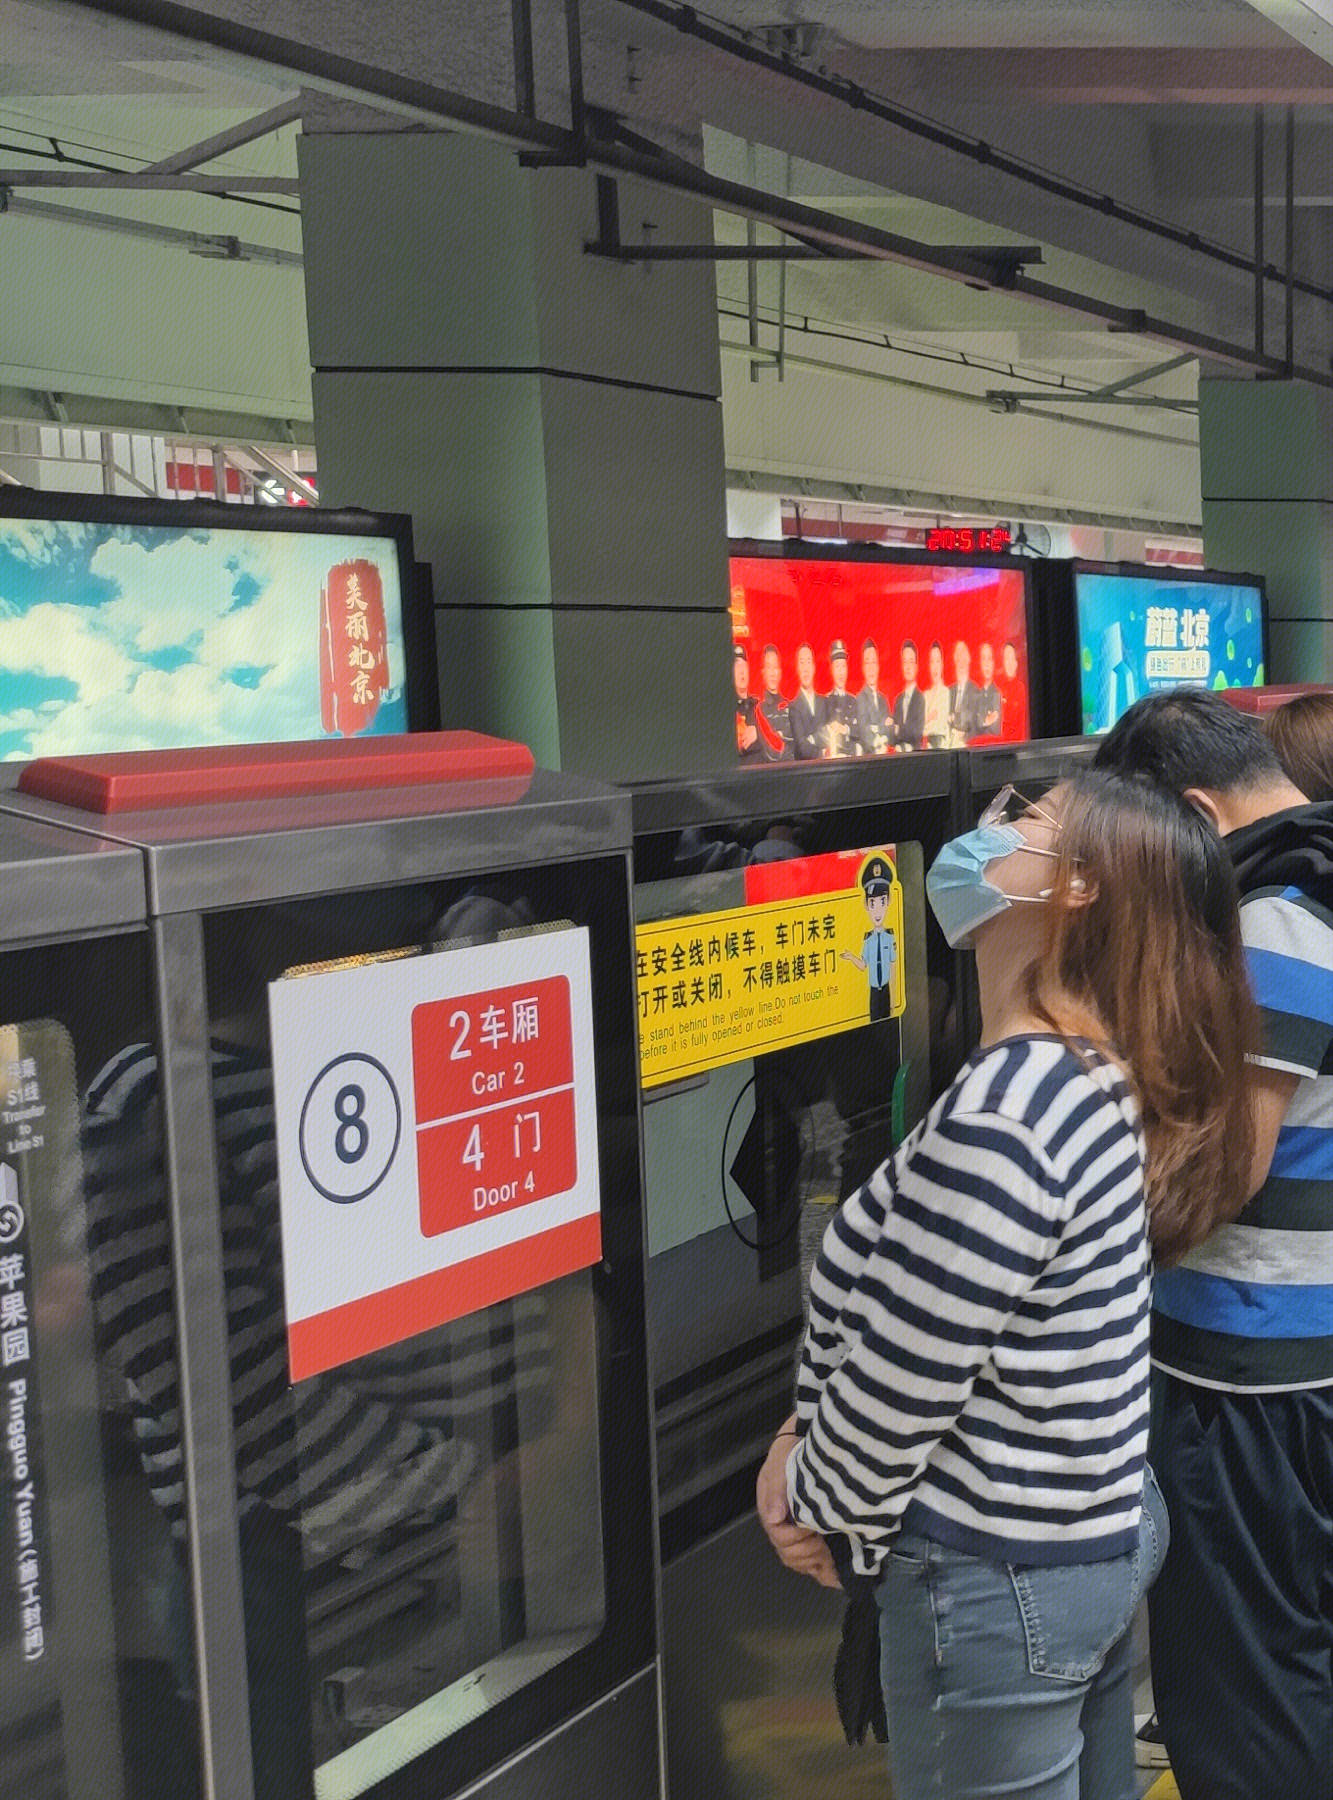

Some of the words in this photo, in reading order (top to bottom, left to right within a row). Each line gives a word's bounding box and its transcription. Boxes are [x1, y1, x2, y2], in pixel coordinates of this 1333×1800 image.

[345, 573, 376, 706] 美丽北京
[650, 1023, 675, 1042] stand
[678, 1015, 708, 1034] behind
[712, 1013, 726, 1026] the
[729, 1005, 755, 1024] yellow
[788, 993, 801, 1007] not
[826, 984, 839, 996] the
[671, 1040, 677, 1052] it
[680, 1037, 688, 1049] is
[691, 1032, 709, 1047] fully
[712, 1021, 743, 1043] opened
[745, 1022, 754, 1032] or
[470, 1070, 506, 1096] Car
[513, 1061, 525, 1086] 2
[334, 1083, 369, 1165] 8
[462, 1123, 485, 1172] 4
[513, 1110, 542, 1160] 门
[473, 1182, 519, 1212] Door
[524, 1170, 536, 1194] 4
[0, 1252, 30, 1368] 苹果园
[7, 1378, 28, 1481] Pingguo
[15, 1481, 35, 1547] Yuan
